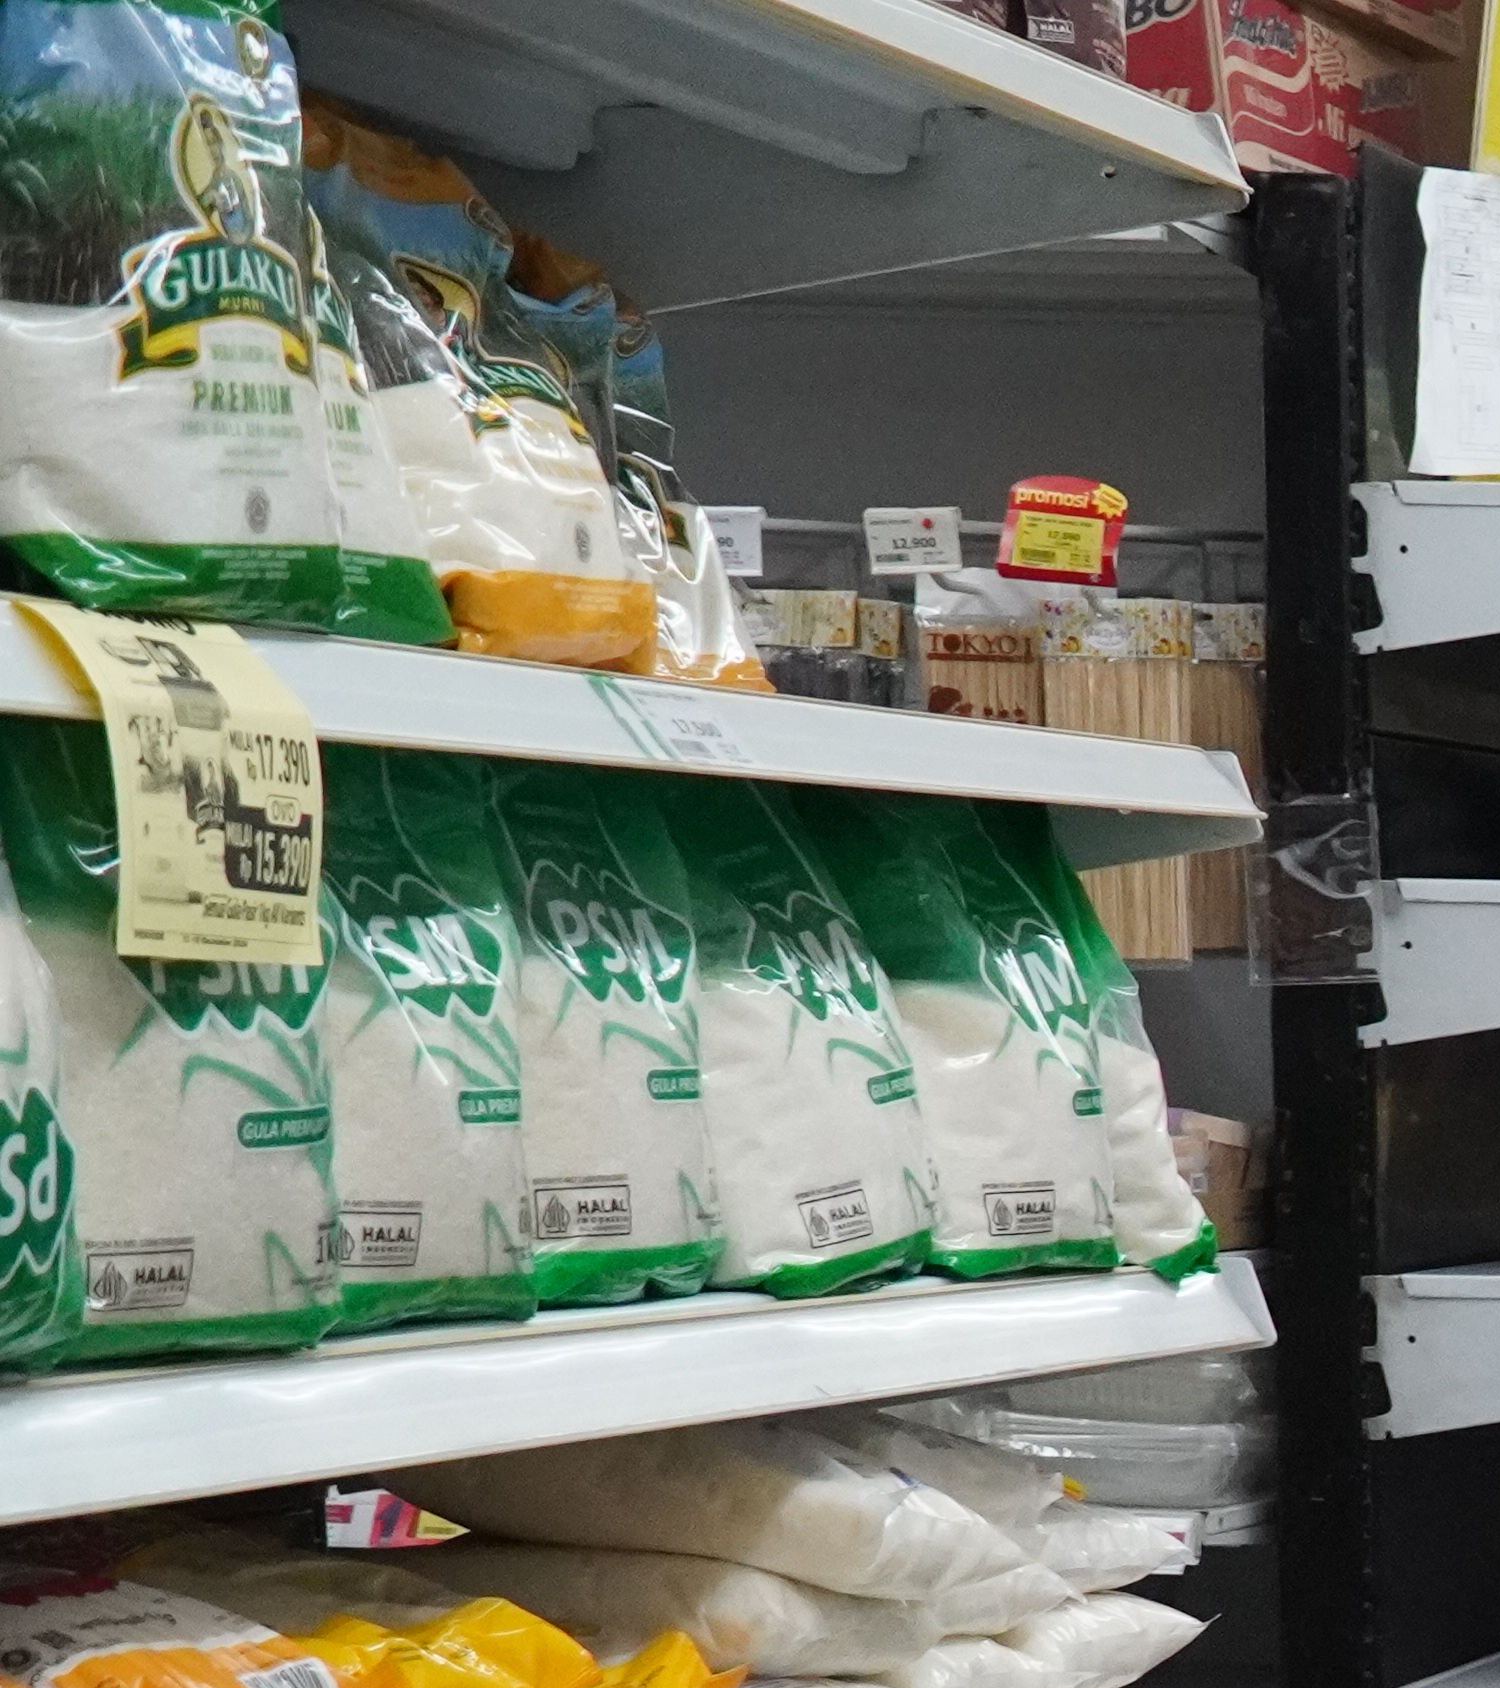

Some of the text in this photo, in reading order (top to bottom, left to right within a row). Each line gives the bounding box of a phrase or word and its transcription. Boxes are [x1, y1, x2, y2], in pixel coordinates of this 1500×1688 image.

[143, 247, 298, 317] GULAKU
[192, 380, 294, 416] PREMIUM
[1015, 488, 1090, 508] promosi
[926, 631, 1018, 655] TOKYO
[254, 734, 311, 787] 17.390
[254, 830, 311, 888] 15.390
[577, 1198, 629, 1217] HALAL
[829, 1203, 869, 1223] HALAL
[1015, 1202, 1055, 1217] HALAL
[361, 1224, 416, 1243] HALAL
[133, 1265, 187, 1287] HALAL
